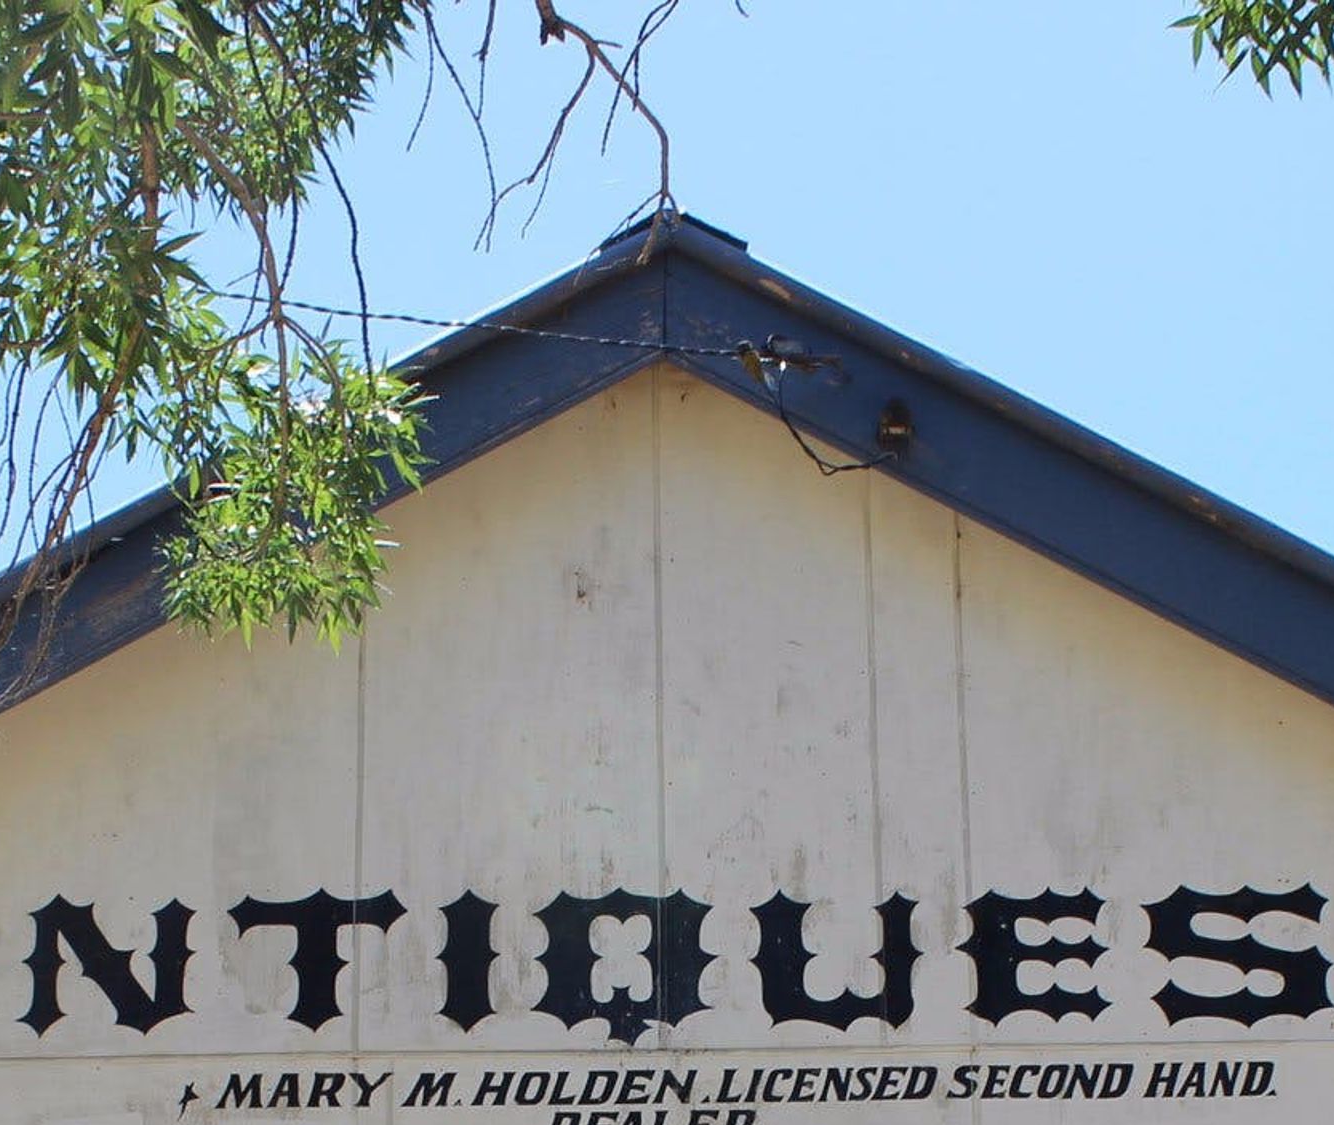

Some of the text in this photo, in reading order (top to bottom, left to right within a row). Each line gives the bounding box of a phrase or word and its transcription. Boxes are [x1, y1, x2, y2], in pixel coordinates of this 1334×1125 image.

[215, 1072, 393, 1109] MARY
[401, 1072, 462, 1108] M.
[946, 1063, 1134, 1100] SECOND
[1143, 1061, 1278, 1098] HAND.
